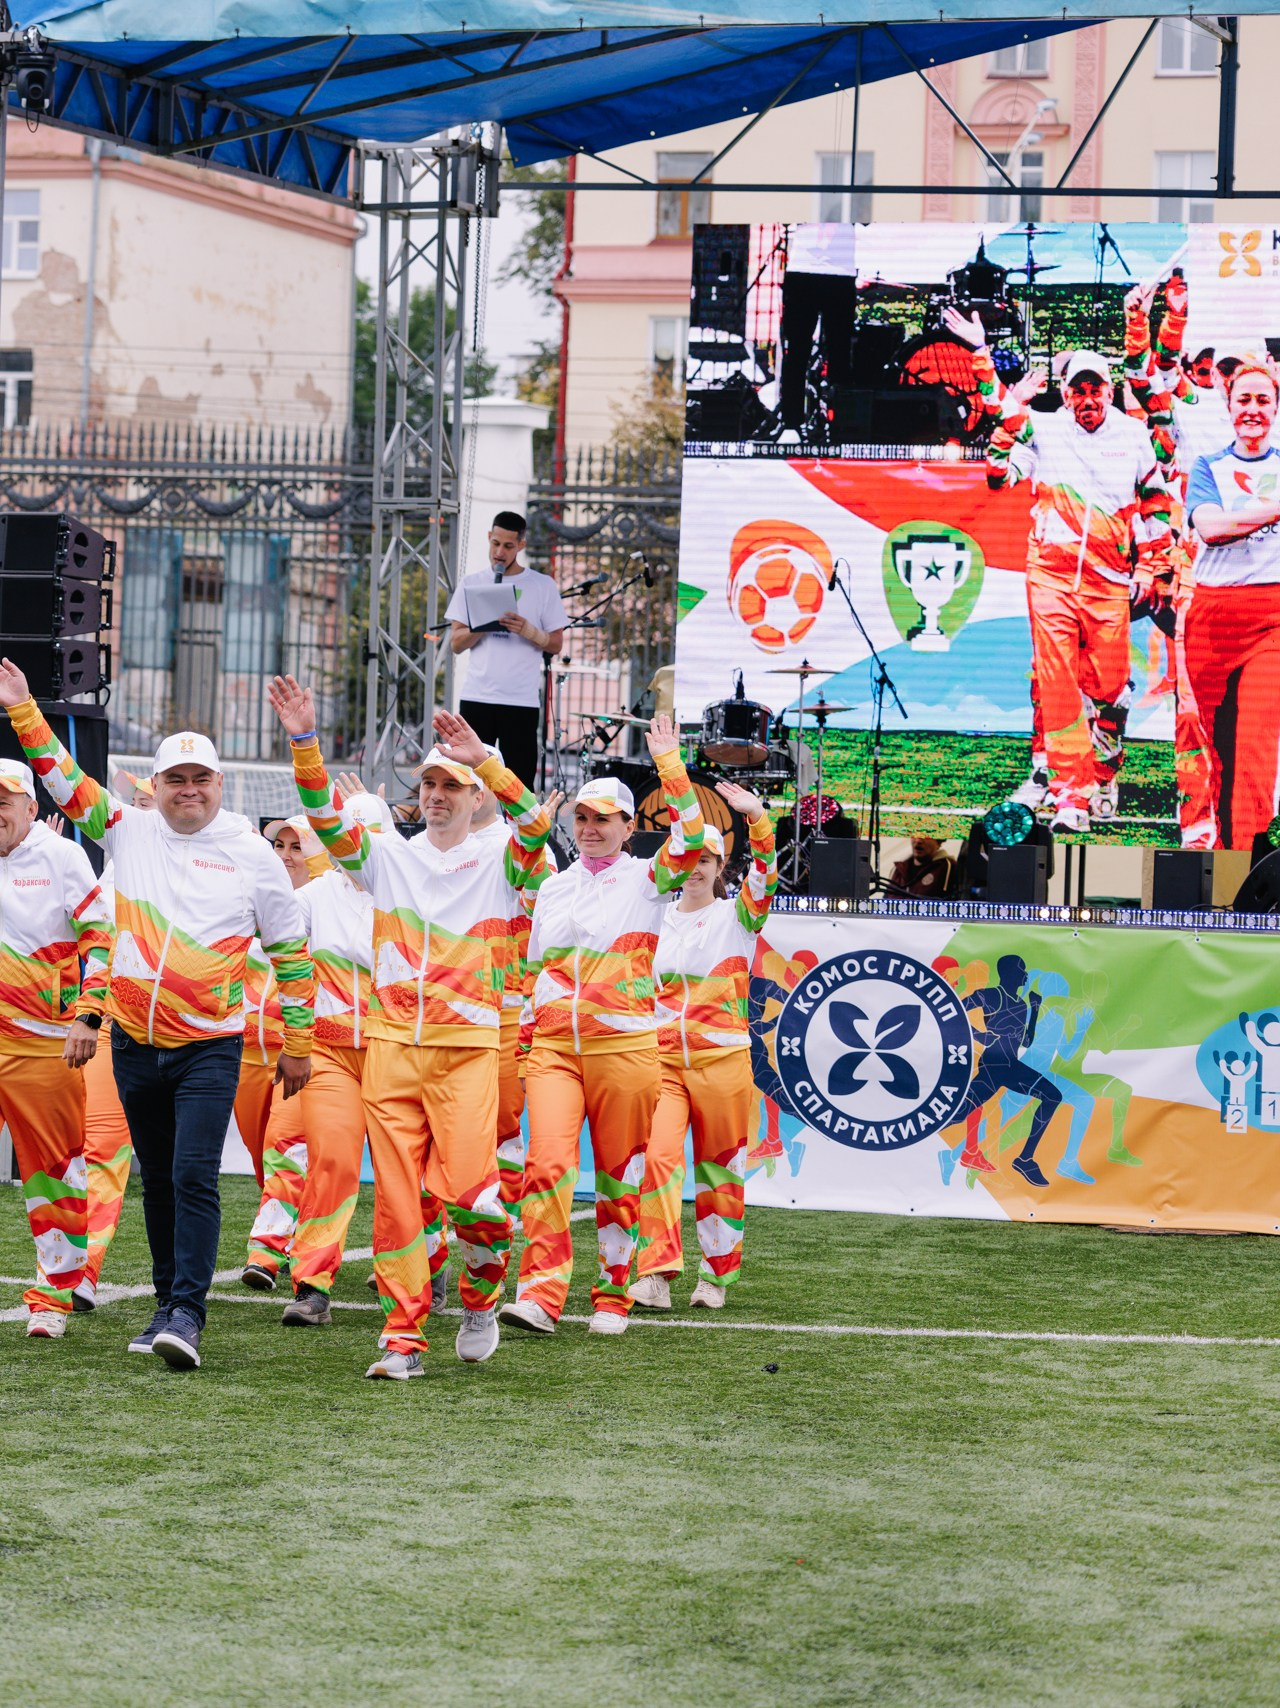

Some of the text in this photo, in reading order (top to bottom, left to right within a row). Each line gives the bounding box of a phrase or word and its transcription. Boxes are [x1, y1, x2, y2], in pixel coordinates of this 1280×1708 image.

[793, 956, 959, 1022] КОМОС ГРУПП
[794, 1080, 959, 1144] СПАРТАКИАДА
[1231, 1108, 1244, 1130] 2
[1268, 1099, 1276, 1120] 1
